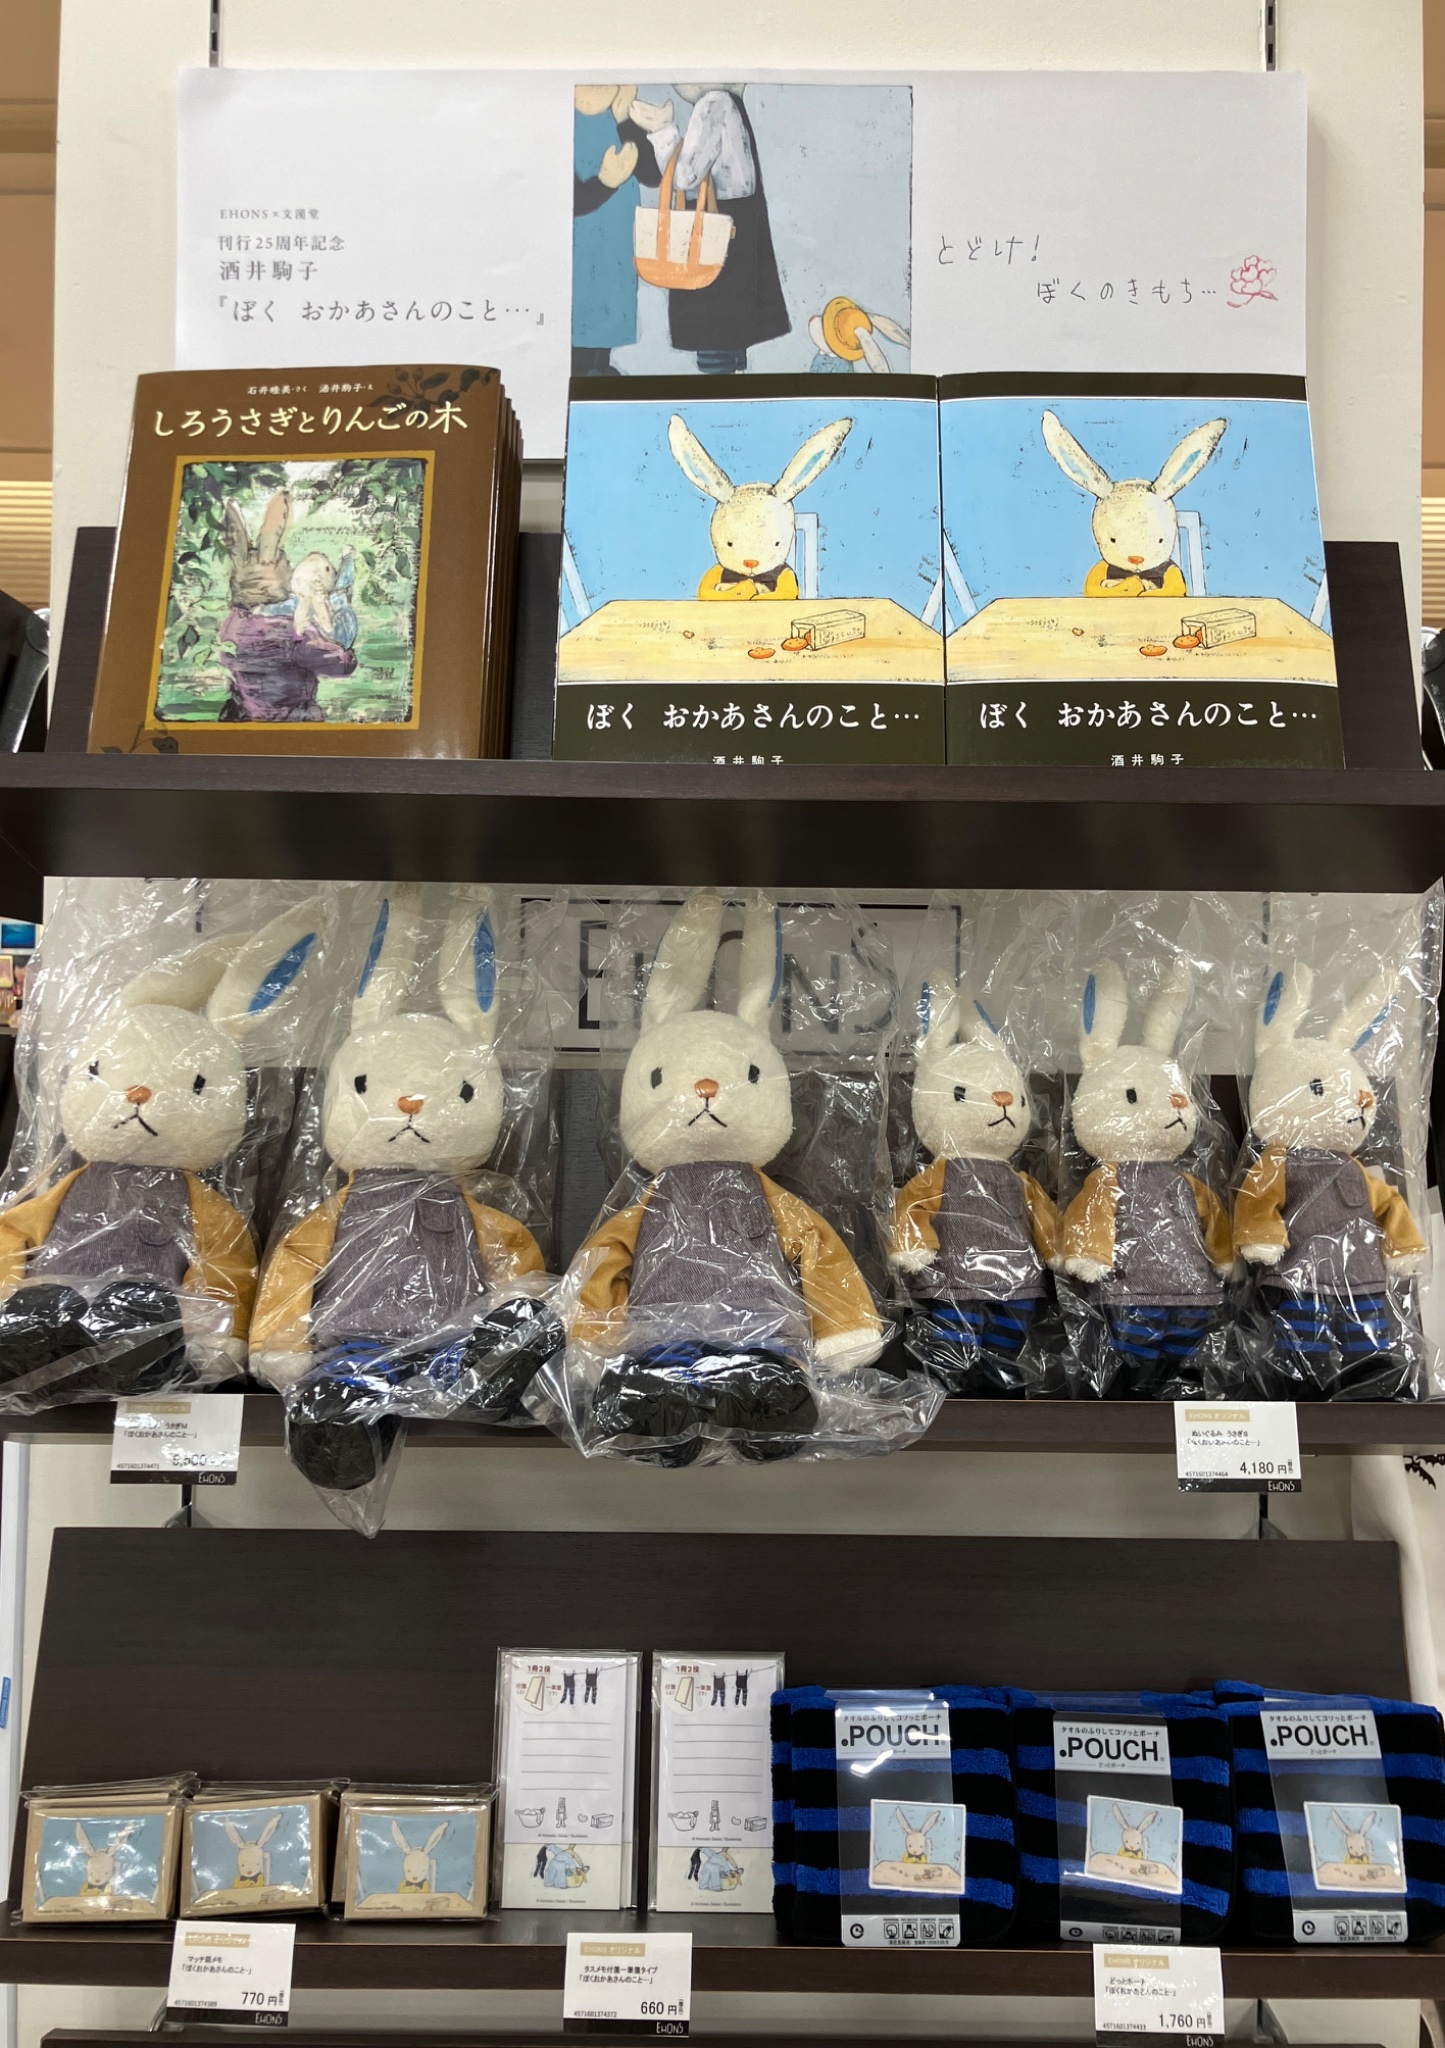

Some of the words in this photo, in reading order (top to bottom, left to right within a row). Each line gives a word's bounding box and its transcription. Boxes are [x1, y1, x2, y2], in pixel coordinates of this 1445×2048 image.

[218, 235, 345, 251] 刊行25周年記念
[938, 234, 1040, 265] とどけ！
[220, 260, 318, 281] 酒井駒子
[154, 401, 468, 437] しろうさぎとりんごの木
[586, 702, 635, 730] ぼく
[978, 701, 1029, 729] ぼく
[1110, 753, 1184, 767] 酒井駒子
[198, 1472, 226, 1484] EHONS
[1268, 1480, 1295, 1492] EHONS
[1061, 1726, 1161, 1738] タオルのふりしてコソッとポーチ
[584, 1945, 608, 1953] EHONS
[609, 1946, 641, 1955] オリジナル
[255, 2012, 283, 2025] EHONS
[656, 2022, 684, 2034] EHONS
[1186, 2035, 1215, 2047] EHONS
